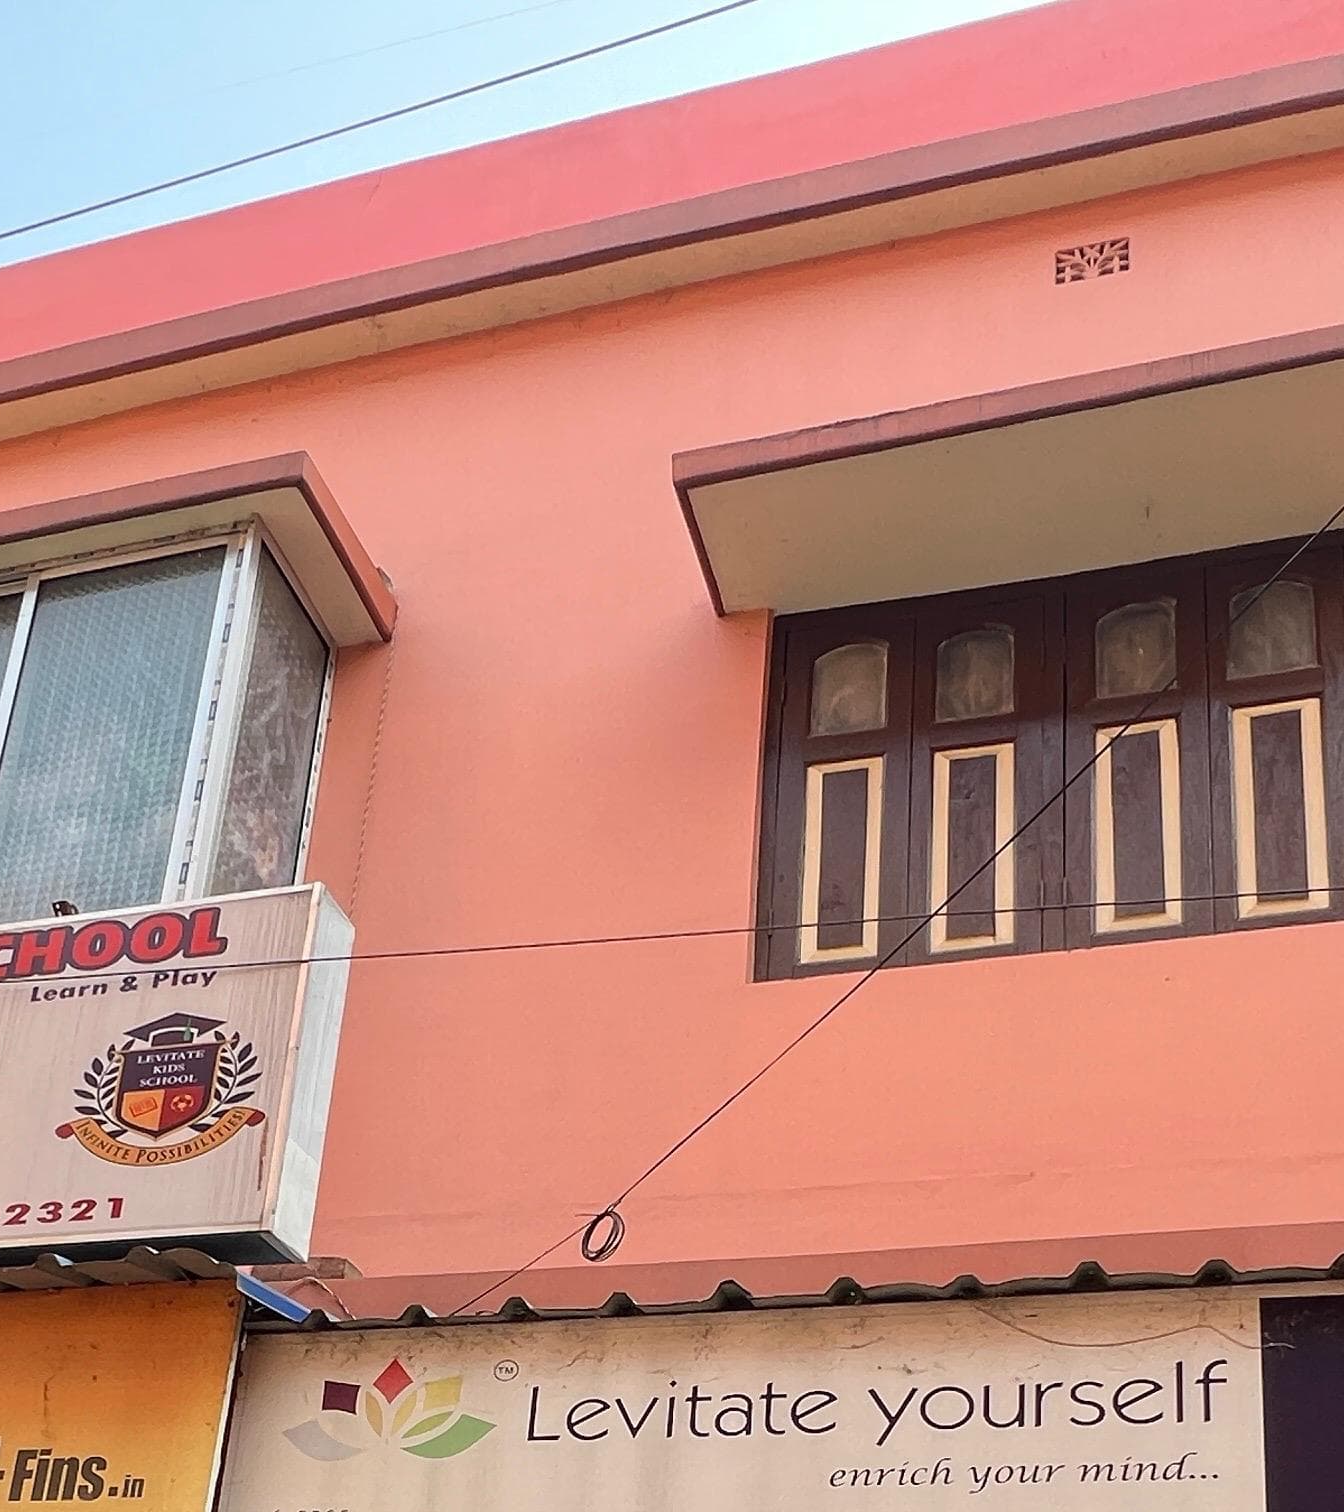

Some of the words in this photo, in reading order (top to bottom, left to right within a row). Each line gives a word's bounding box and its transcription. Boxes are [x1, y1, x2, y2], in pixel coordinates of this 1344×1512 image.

[31, 976, 108, 1003] Learn
[120, 975, 138, 992] &
[152, 968, 218, 990] Play
[138, 1050, 205, 1064] LEVITATE
[153, 1063, 185, 1074] KIDS
[139, 1074, 197, 1087] SCHOOL
[76, 1120, 130, 1160] INFINITE
[527, 1379, 838, 1441] Levitate
[868, 1359, 1228, 1447] yourself
[829, 1457, 953, 1488] enrich
[968, 1459, 1065, 1495] your
[1077, 1452, 1219, 1484] mind...
